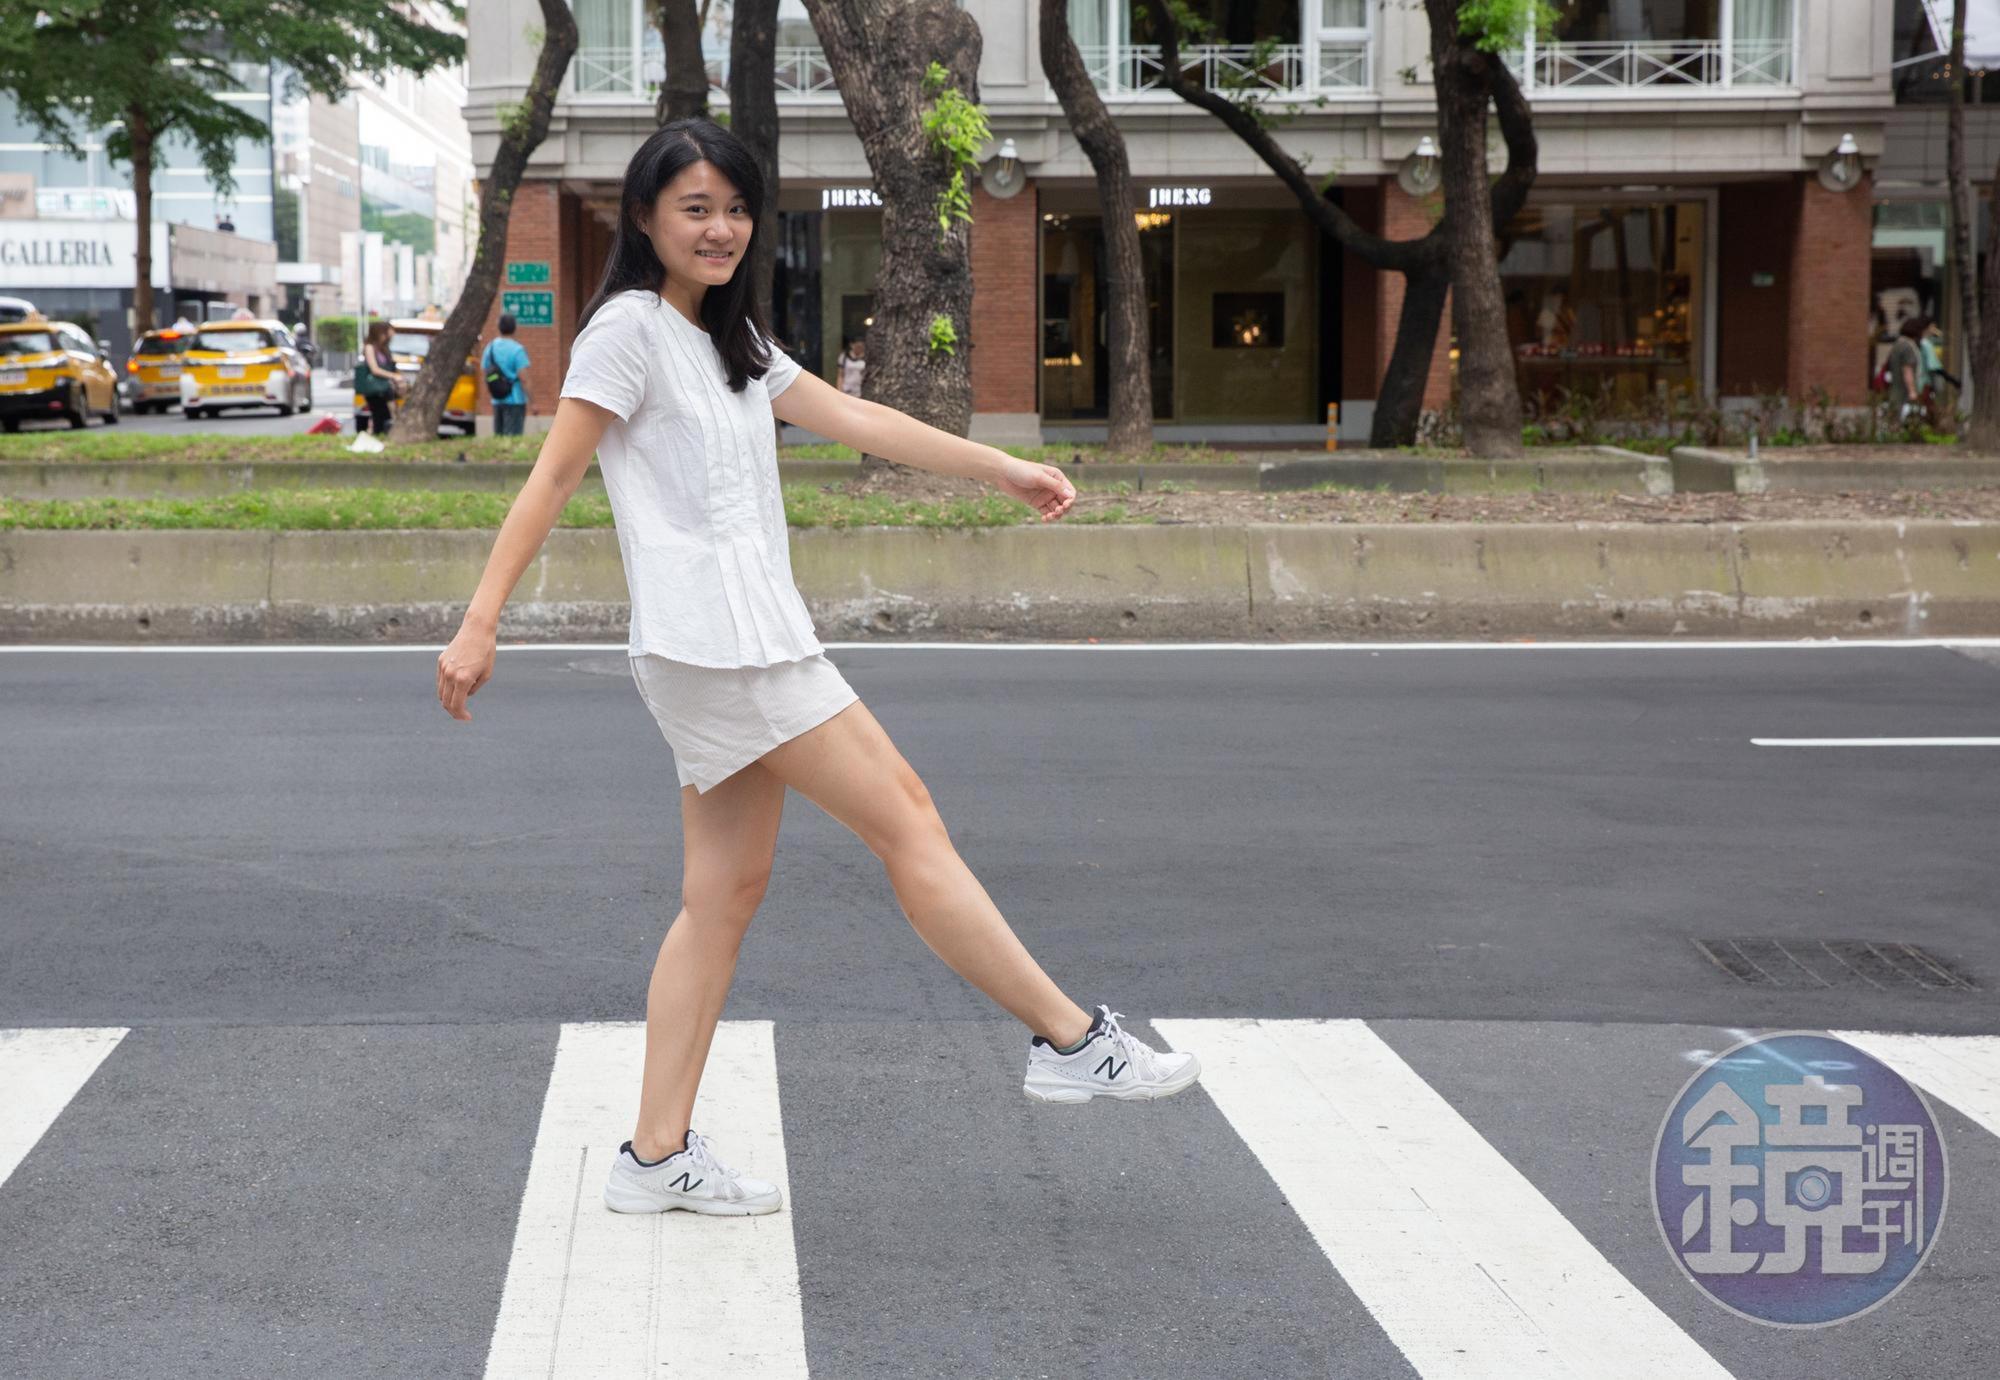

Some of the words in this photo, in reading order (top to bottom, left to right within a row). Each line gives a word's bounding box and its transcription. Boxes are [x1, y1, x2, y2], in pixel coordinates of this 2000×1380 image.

[0, 240, 113, 266] GALLERIA
[1094, 1056, 1127, 1080] N
[669, 1172, 703, 1192] N
